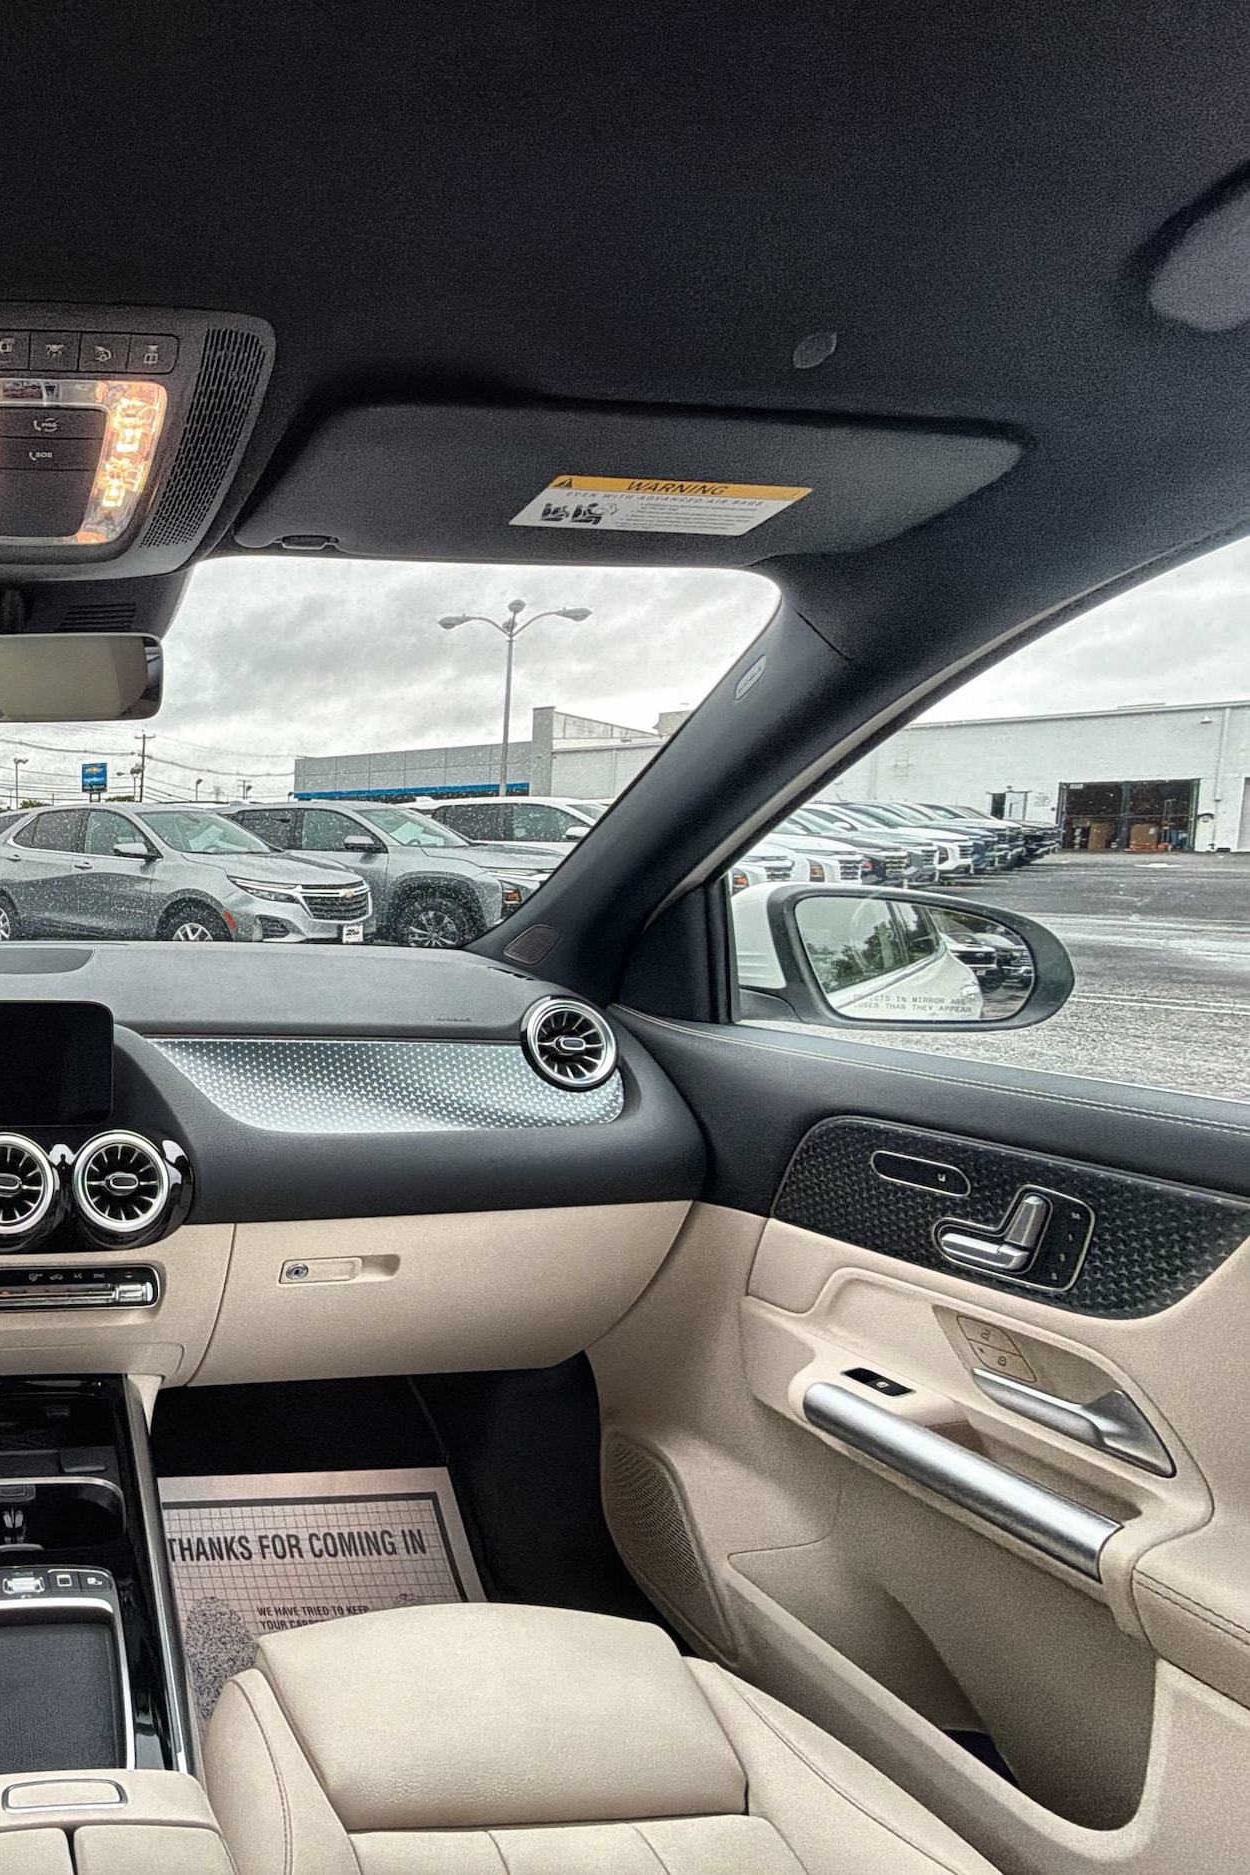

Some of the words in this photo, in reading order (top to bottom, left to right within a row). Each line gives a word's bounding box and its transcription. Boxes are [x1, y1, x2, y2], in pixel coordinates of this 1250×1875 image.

[35, 451, 53, 459] SOS
[627, 480, 729, 496] WARNING
[167, 1535, 253, 1562] THANKS
[258, 1533, 304, 1560] FOR
[308, 1529, 397, 1558] COMING
[401, 1528, 427, 1555] IN
[257, 1606, 272, 1617] WE
[274, 1606, 299, 1617] HAVE
[301, 1606, 330, 1616] TRIED
[332, 1605, 345, 1615] TO
[346, 1605, 370, 1615] KEEP
[259, 1620, 288, 1631] YOUR
